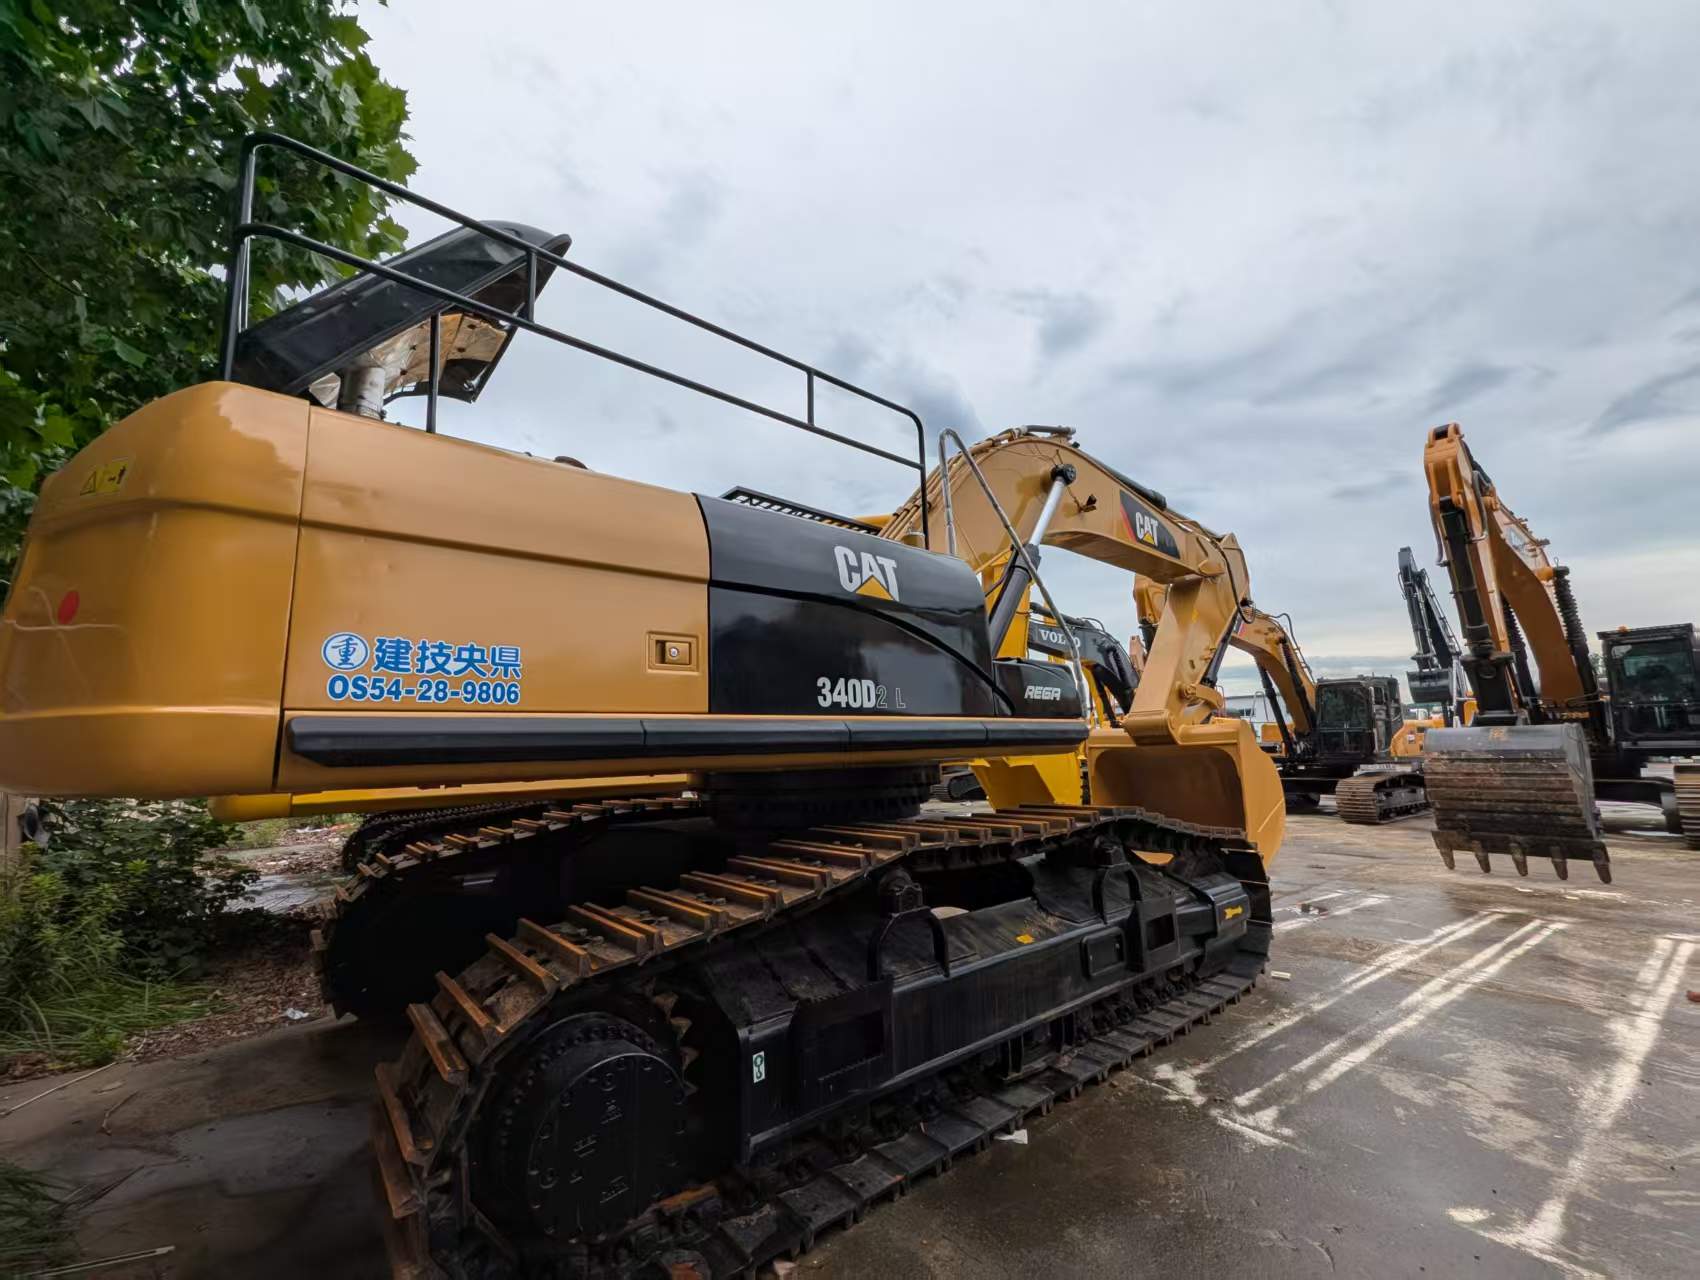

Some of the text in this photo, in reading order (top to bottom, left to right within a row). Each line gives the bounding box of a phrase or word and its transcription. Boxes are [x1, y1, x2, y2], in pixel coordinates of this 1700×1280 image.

[1135, 511, 1159, 546] CAT
[834, 545, 900, 602] CAT
[1039, 628, 1081, 648] VOLO
